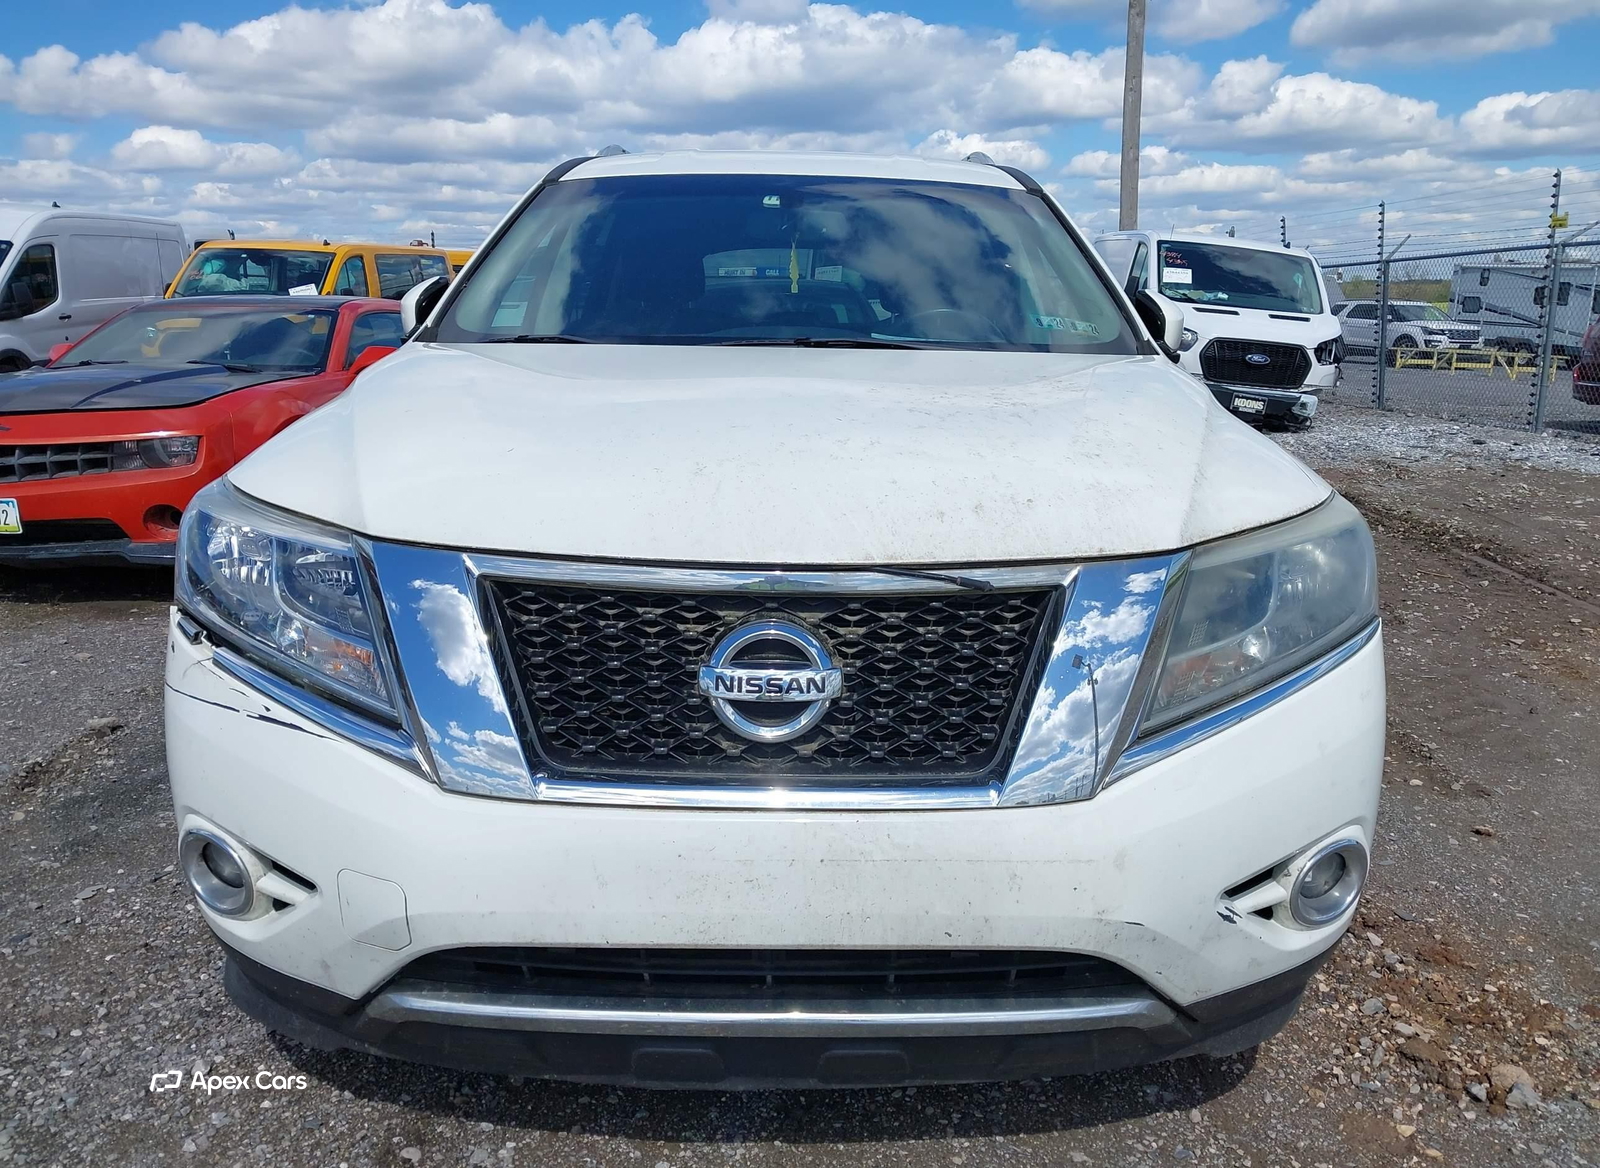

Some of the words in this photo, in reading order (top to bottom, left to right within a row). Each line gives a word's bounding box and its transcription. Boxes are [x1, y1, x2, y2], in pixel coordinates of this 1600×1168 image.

[1234, 397, 1264, 410] KOONS
[0, 508, 10, 526] 2
[714, 674, 826, 695] NISSAN
